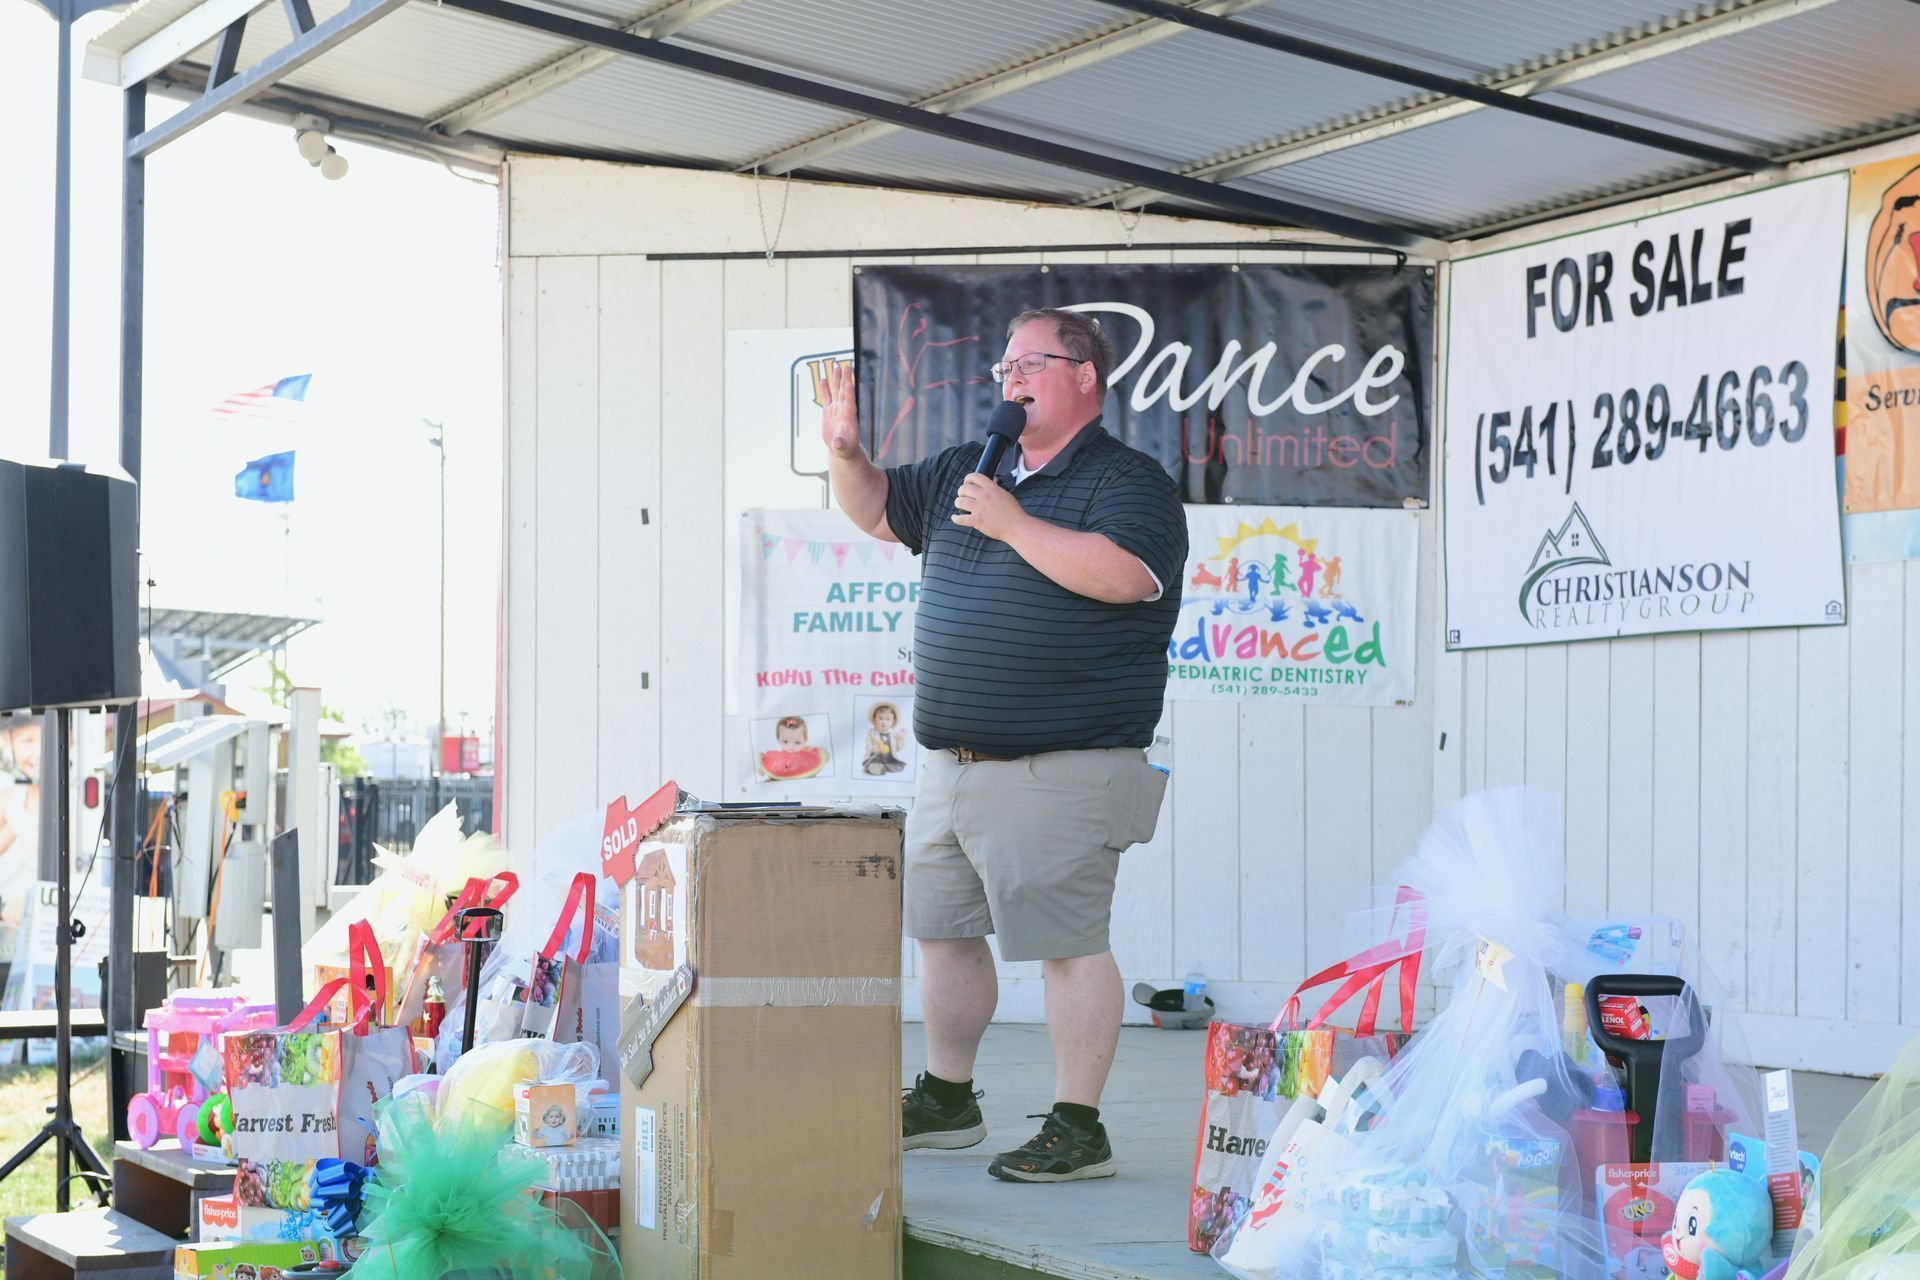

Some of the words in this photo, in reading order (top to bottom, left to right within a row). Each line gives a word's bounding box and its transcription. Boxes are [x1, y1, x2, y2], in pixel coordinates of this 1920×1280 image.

[1526, 249, 1615, 339] FOR
[1628, 217, 1753, 318] SALE
[1182, 416, 1397, 470] Unlimited
[1474, 399, 1576, 506] (541)
[1591, 360, 1810, 470] 289-4663
[1536, 560, 1752, 607] CHRISTIANSON
[793, 611, 903, 633] FAMILY
[821, 668, 863, 686] The
[1168, 664, 1263, 683] PEDIATRIC
[1271, 665, 1368, 685] DENTISTRY
[1211, 684, 1248, 696] (541)
[1252, 684, 1319, 697] 289-5433
[603, 817, 638, 861] SOLD
[1206, 1124, 1271, 1158] Harve
[1621, 1200, 1655, 1221] UNO
